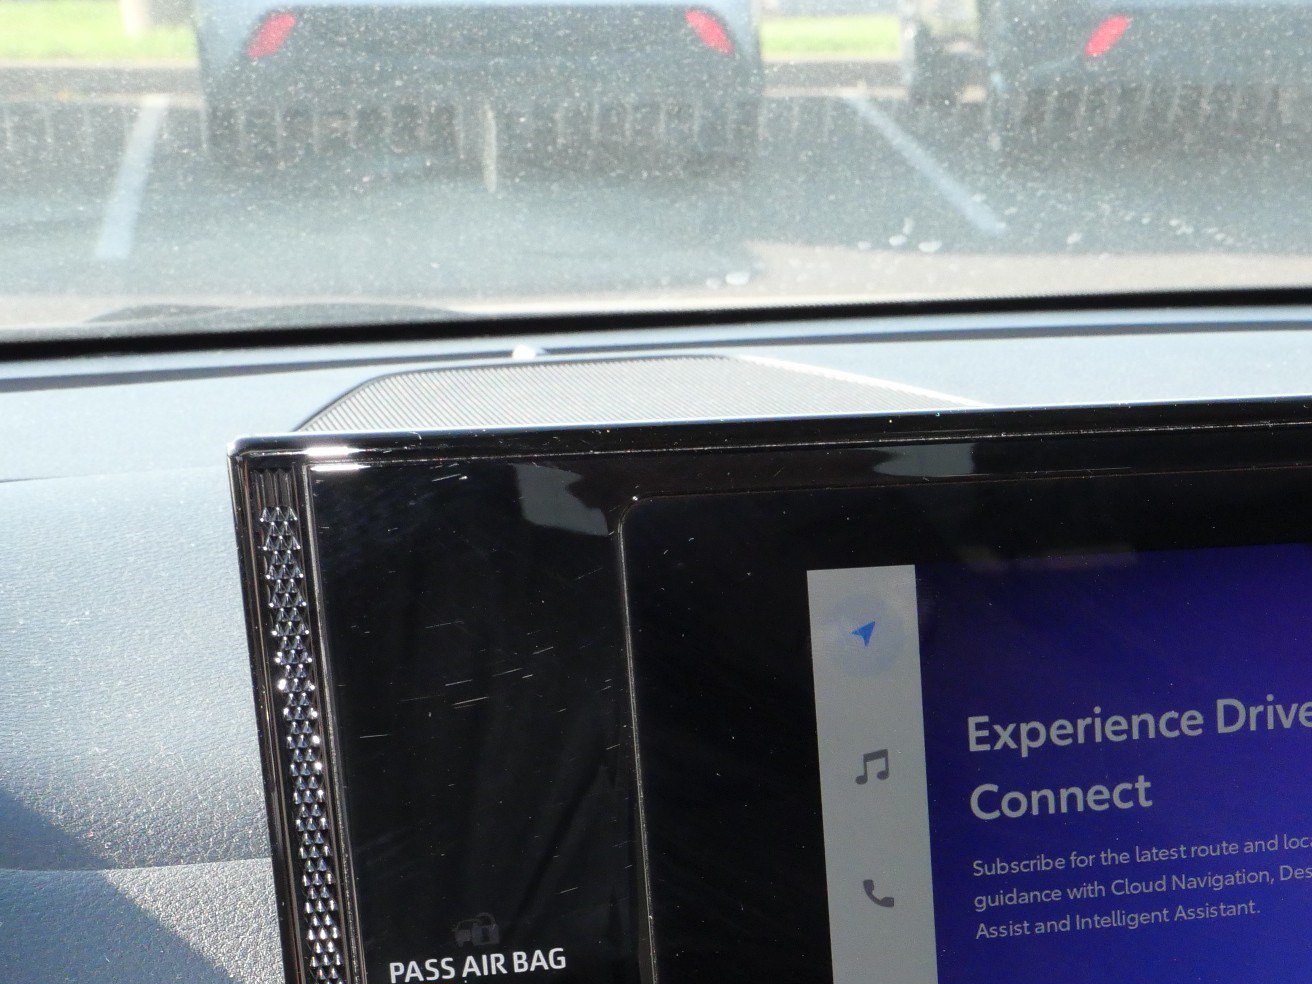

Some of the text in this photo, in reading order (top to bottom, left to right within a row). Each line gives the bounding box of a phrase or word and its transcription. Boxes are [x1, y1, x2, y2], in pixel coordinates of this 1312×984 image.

[967, 706, 1204, 758] Experience
[970, 775, 1152, 820] Connect
[973, 853, 1066, 877] Subscribe
[1070, 851, 1096, 869] for
[1100, 849, 1130, 866] the
[1136, 844, 1187, 863] latest
[1191, 840, 1239, 858] route
[1244, 834, 1279, 853] and
[974, 888, 1062, 912] guidance
[1067, 881, 1106, 900] with
[1111, 875, 1166, 896] Cloud
[1171, 868, 1275, 891] Navigation,
[975, 901, 1261, 939] Assist and Intelligent Assistant.
[389, 947, 567, 984] PASS AIR BAG
